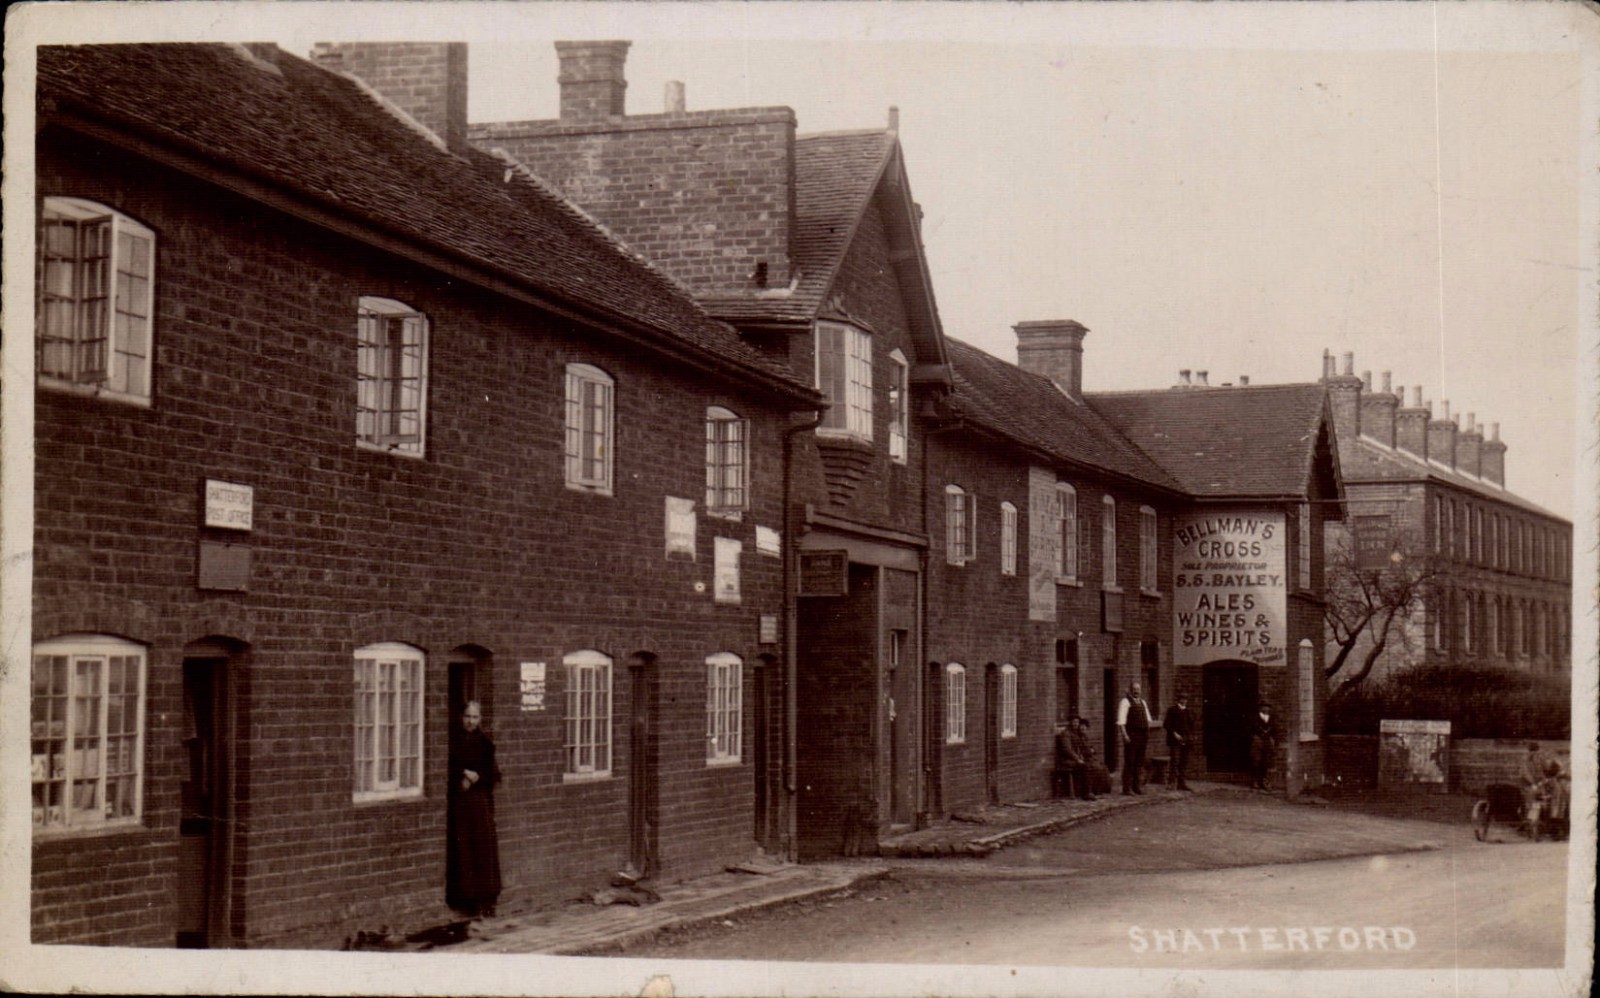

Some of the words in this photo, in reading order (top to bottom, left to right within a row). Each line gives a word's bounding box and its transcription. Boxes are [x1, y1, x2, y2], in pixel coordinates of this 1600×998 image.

[1176, 517, 1275, 547] BELLMAN'S
[1198, 541, 1261, 559] CROSS
[1204, 561, 1268, 571] PROPRIETOR
[1196, 593, 1255, 611] ALES
[1178, 612, 1246, 628] WINES
[1254, 613, 1270, 628] &
[1182, 629, 1271, 647] SPIRITS
